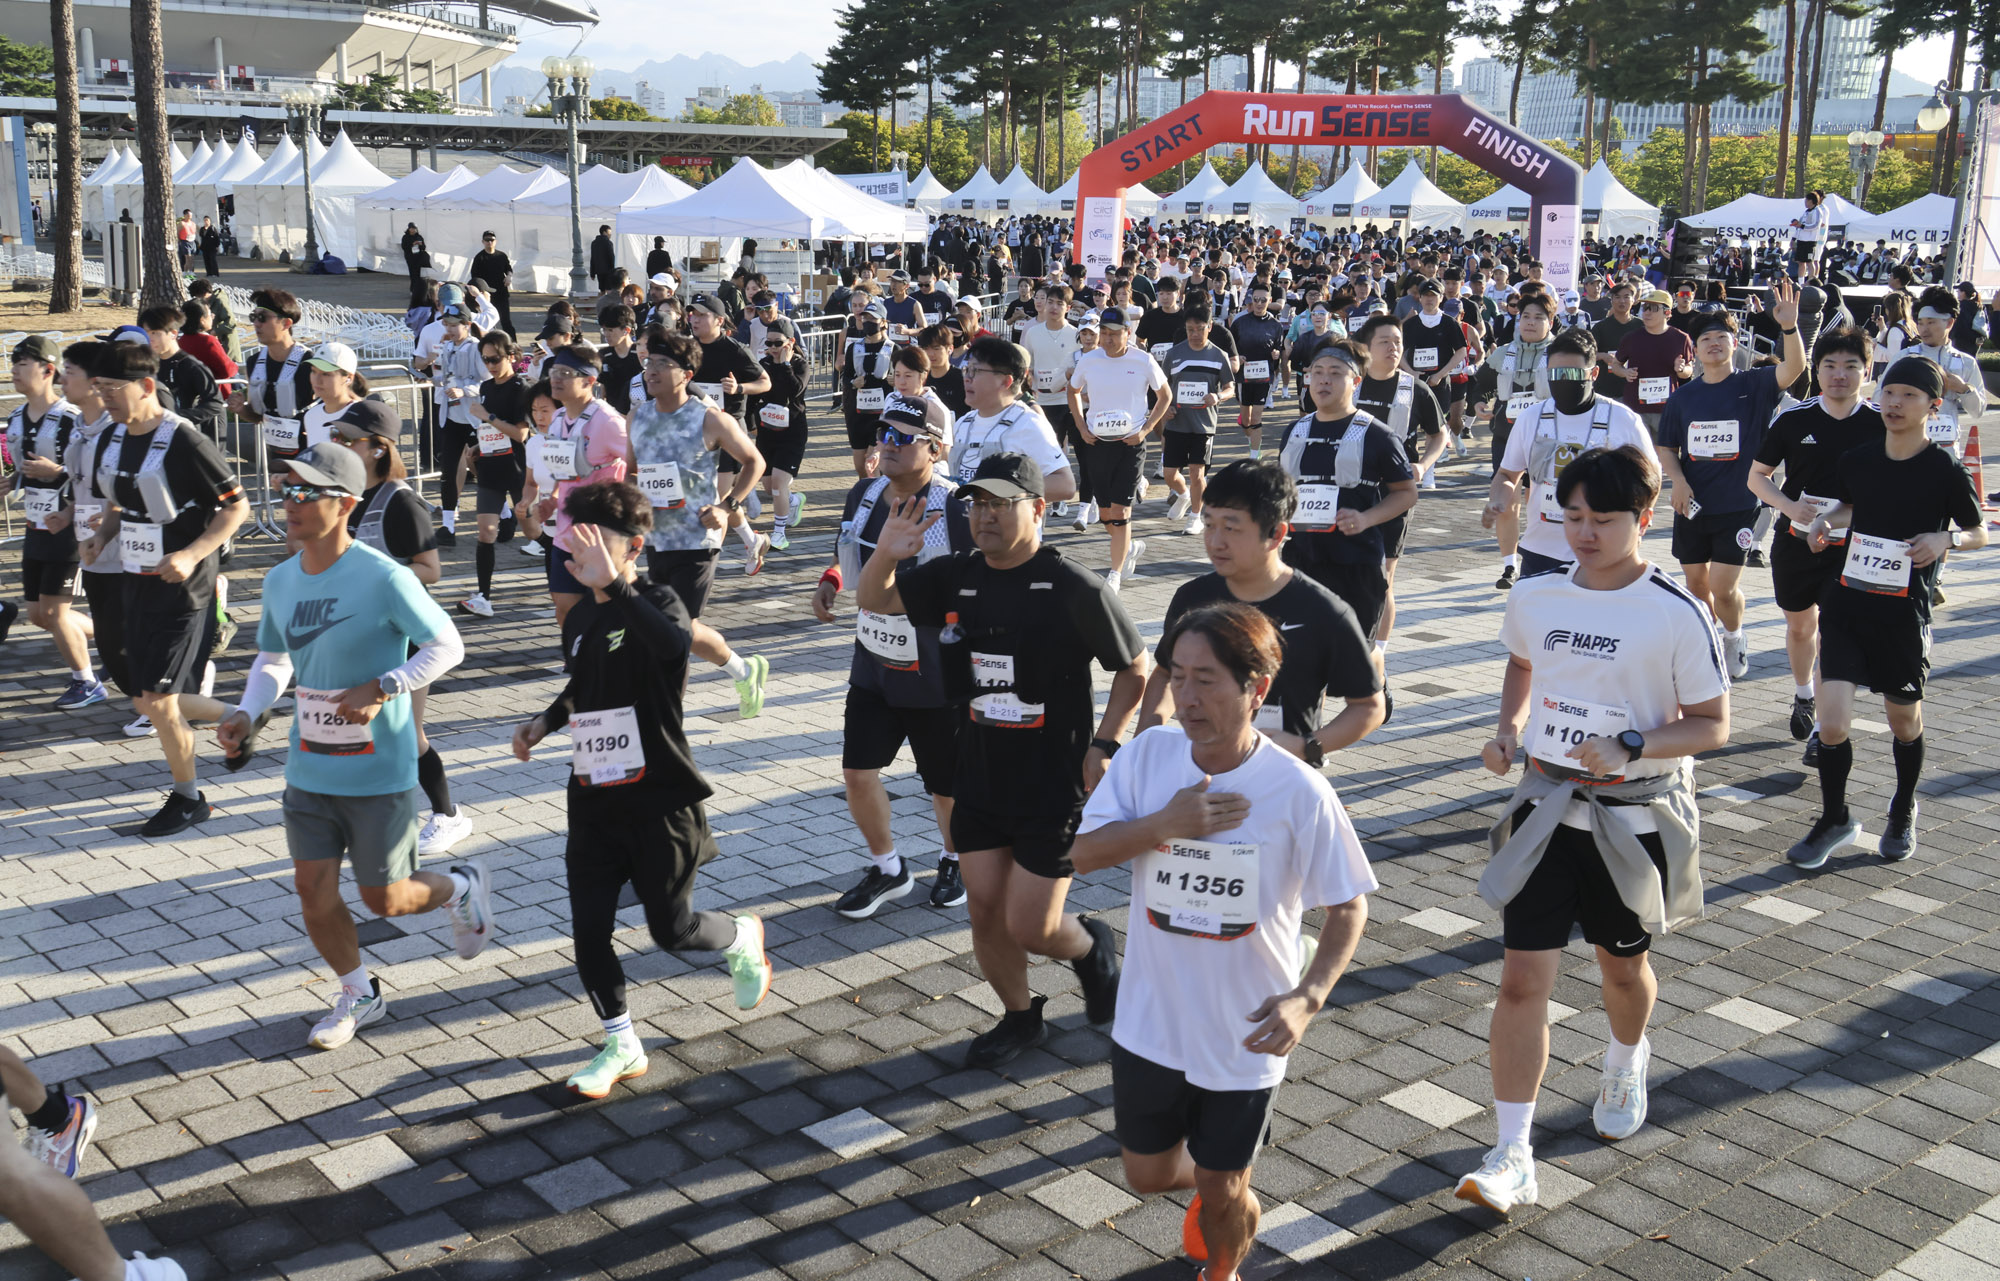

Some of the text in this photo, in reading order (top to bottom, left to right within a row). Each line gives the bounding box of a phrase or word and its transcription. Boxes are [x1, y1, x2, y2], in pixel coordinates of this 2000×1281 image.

[1243, 103, 1315, 136] Run
[1120, 113, 1203, 172] START
[1463, 116, 1551, 180] FINISH
[1748, 227, 1789, 239] ROOM
[1891, 228, 1917, 241] MC
[767, 412, 785, 421] 2568
[1105, 420, 1127, 428] 1744
[1928, 425, 1952, 433] 1172
[271, 429, 294, 439] 1228
[484, 433, 505, 442] 2525
[1704, 433, 1733, 443] 1243
[550, 454, 570, 465] 1065
[647, 478, 674, 490] 1066
[29, 501, 52, 513] 1472
[1300, 500, 1331, 511] 1022
[1852, 535, 1862, 545] Run
[124, 540, 155, 553] 1843
[1851, 552, 1902, 571] M 1726
[292, 597, 339, 628] NIKE
[862, 625, 908, 647] M 1379
[1571, 631, 1621, 653] HAPPS
[990, 707, 1018, 718] B-215
[1543, 697, 1558, 711] Run
[1605, 709, 1627, 719] 10km
[302, 711, 310, 721] M
[1544, 723, 1556, 737] M
[585, 734, 630, 753] 1390
[1155, 843, 1171, 855] un
[1231, 848, 1255, 856] 10km
[1156, 870, 1245, 898] M 1356
